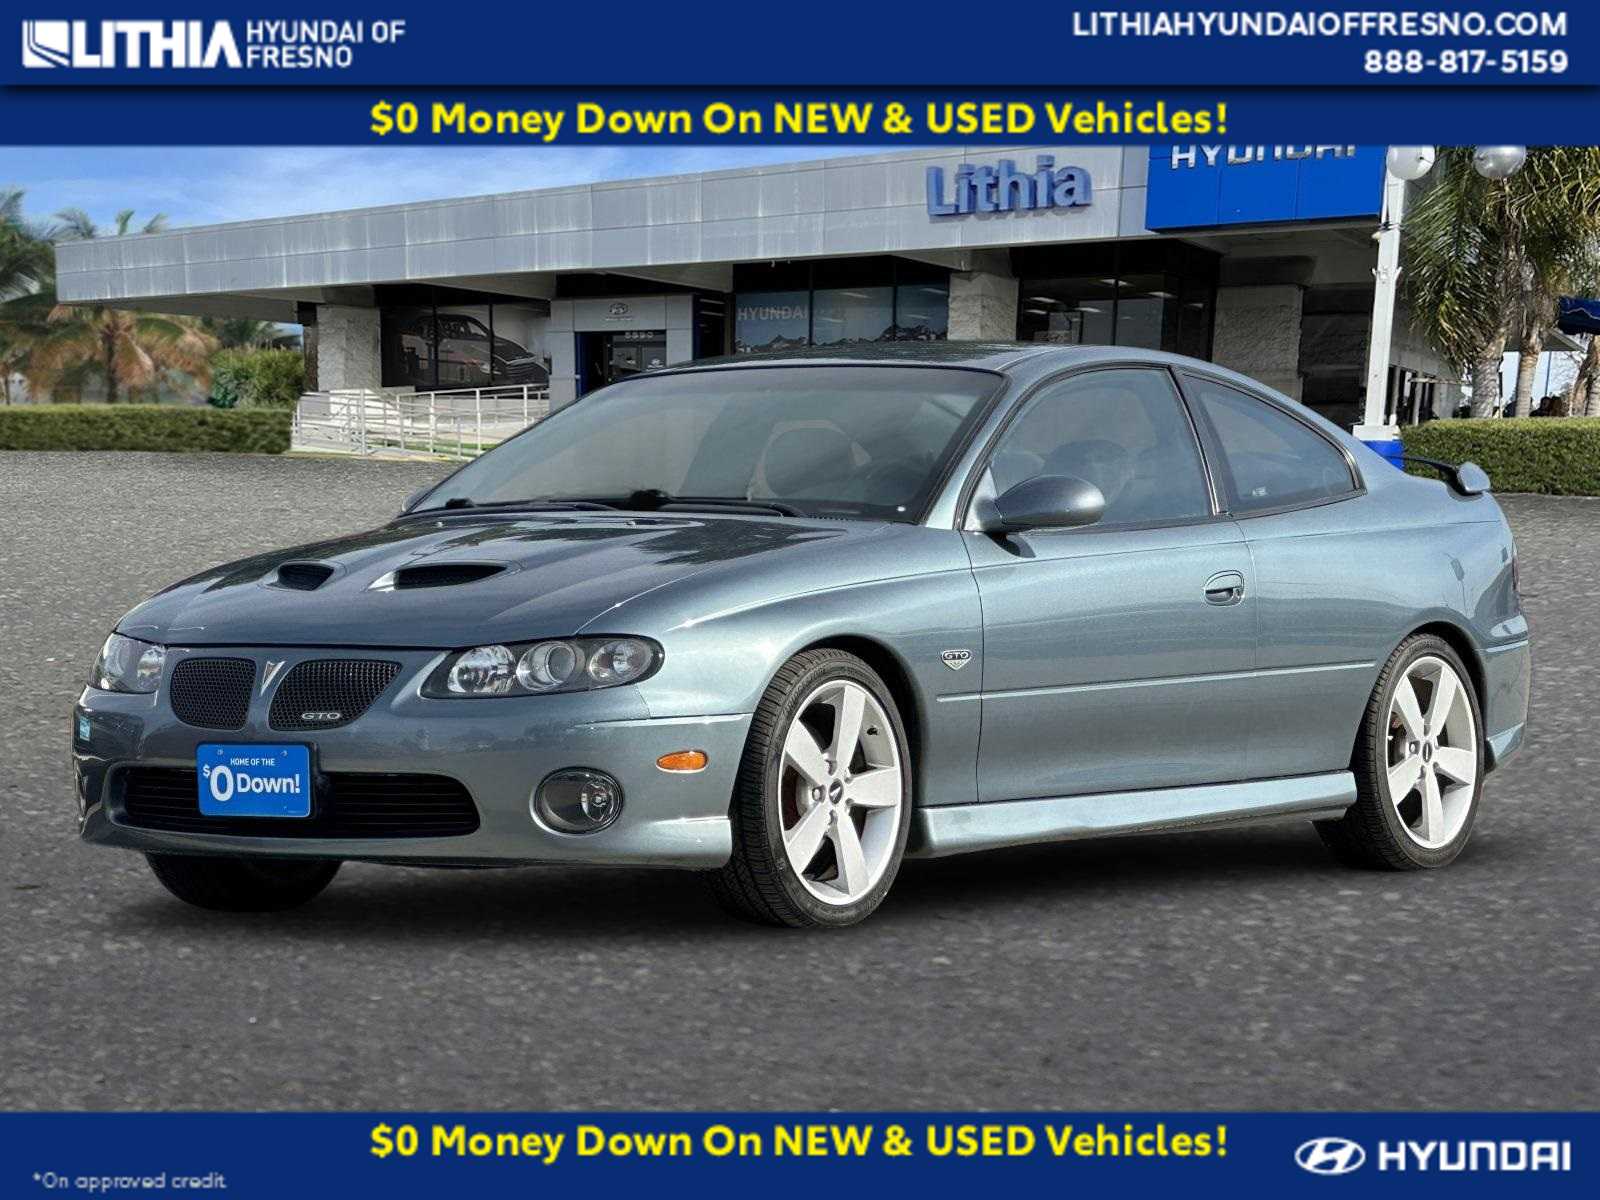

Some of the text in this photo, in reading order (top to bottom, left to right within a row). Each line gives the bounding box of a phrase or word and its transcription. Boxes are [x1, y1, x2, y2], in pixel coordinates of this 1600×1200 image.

[926, 155, 1092, 216] Lithia
[737, 305, 810, 321] HYUNDAI
[943, 651, 969, 660] GTO
[301, 711, 341, 720] GTO
[230, 757, 276, 767] HOME OF THE
[236, 773, 301, 794] Down!
